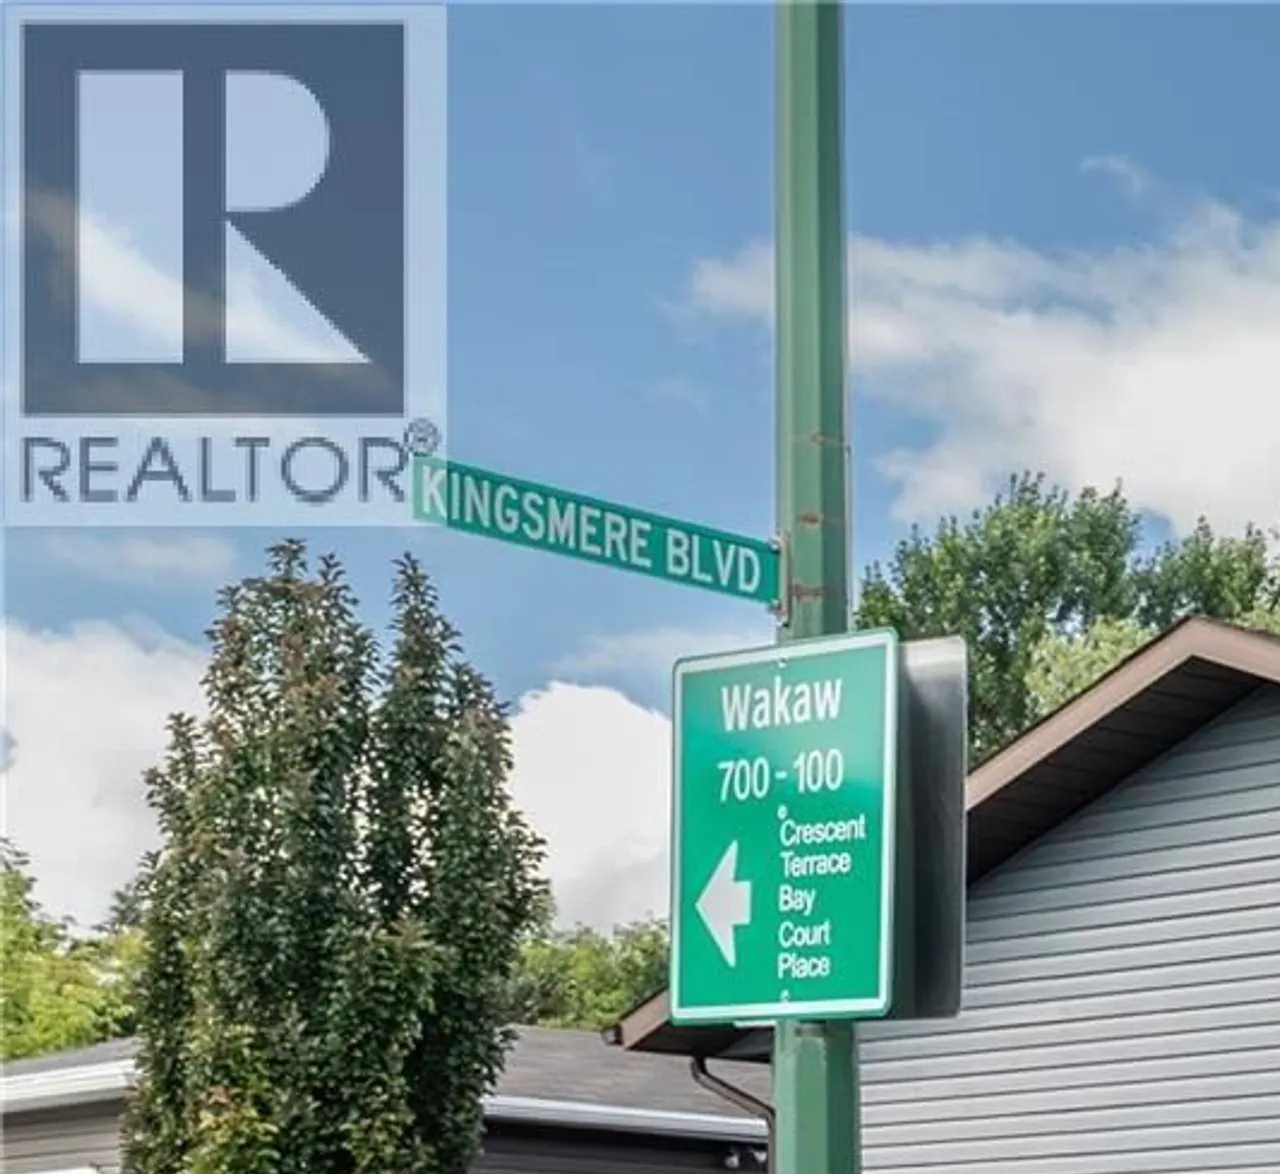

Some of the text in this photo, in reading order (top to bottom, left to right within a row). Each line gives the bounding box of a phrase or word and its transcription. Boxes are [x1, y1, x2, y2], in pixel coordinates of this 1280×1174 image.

[421, 464, 761, 593] KINGSMERE BLVD
[721, 676, 842, 732] Wakaw
[780, 814, 866, 846] Crescent
[780, 851, 851, 878] Terrace
[779, 885, 814, 916] Bay
[778, 921, 831, 948] Court
[777, 952, 831, 980] Place
